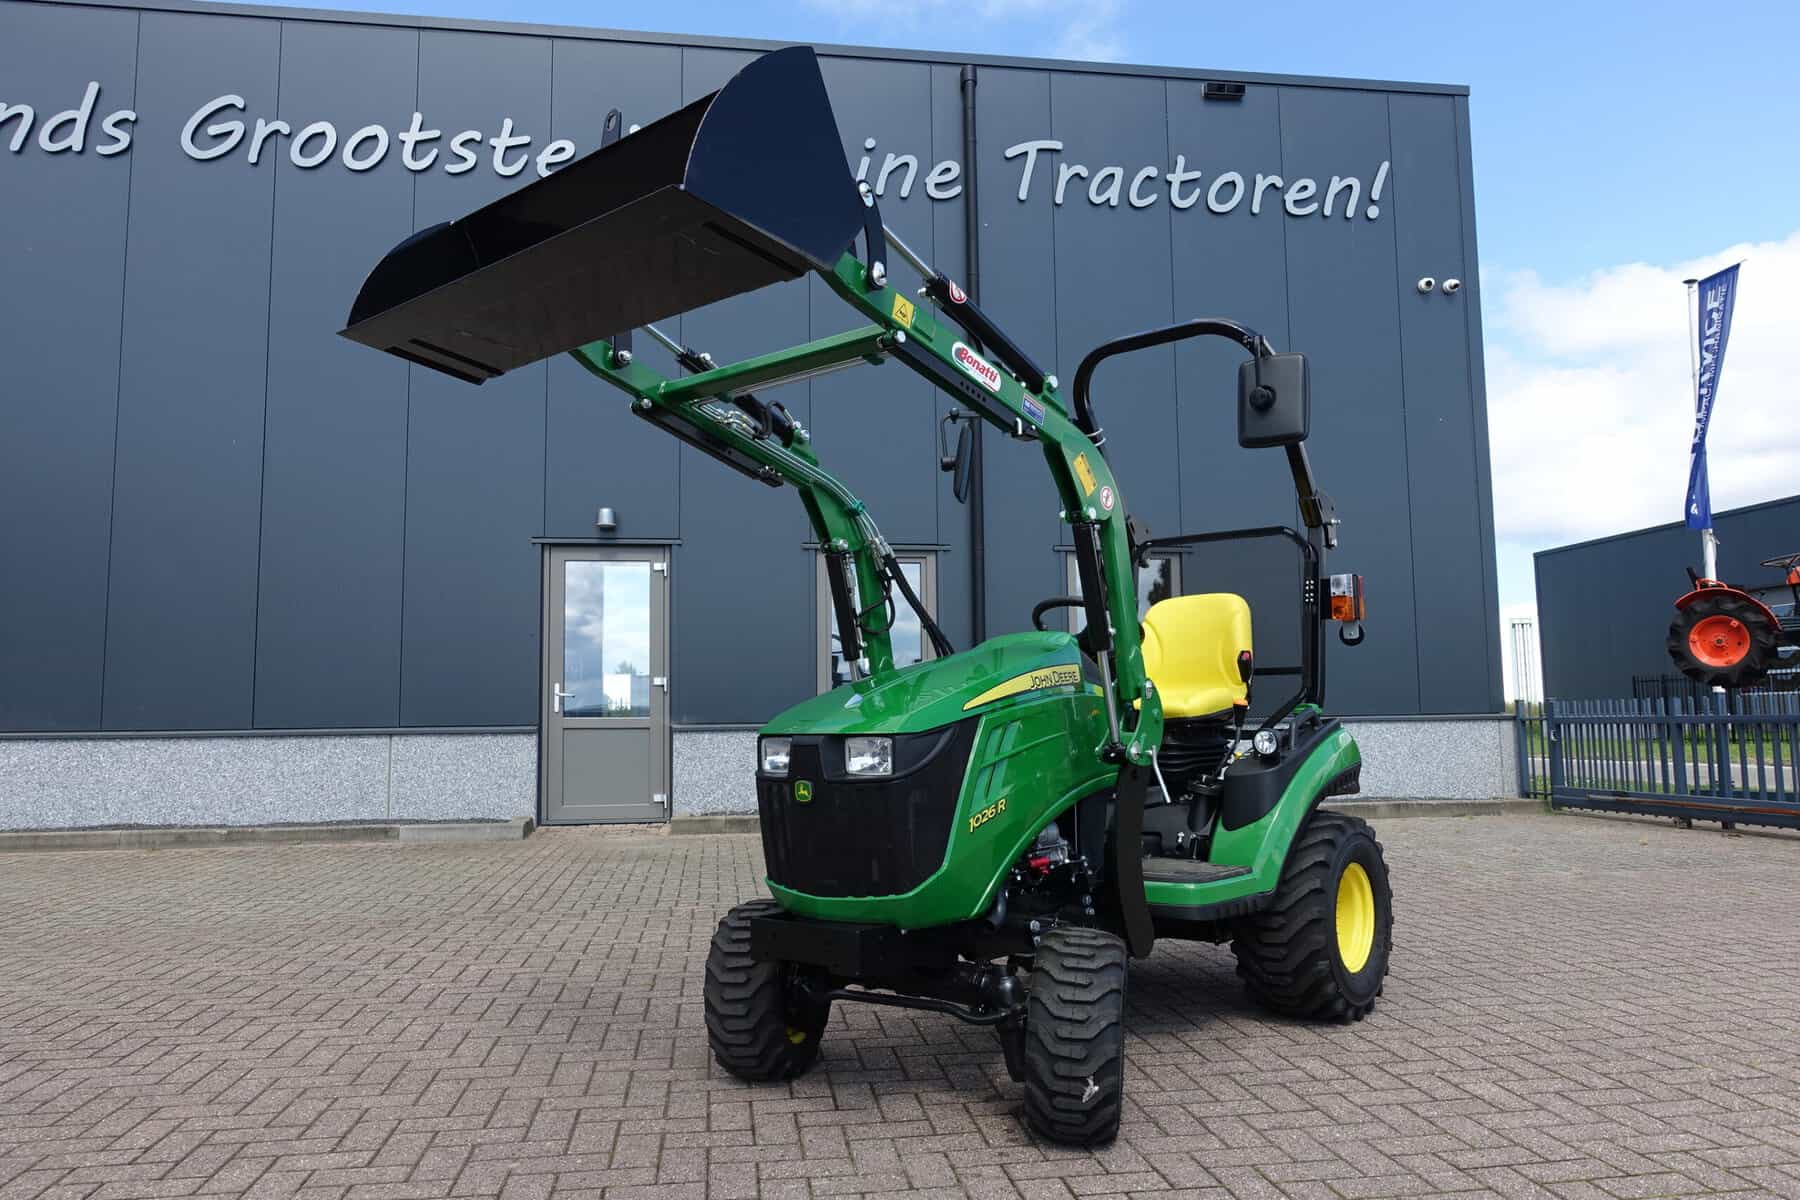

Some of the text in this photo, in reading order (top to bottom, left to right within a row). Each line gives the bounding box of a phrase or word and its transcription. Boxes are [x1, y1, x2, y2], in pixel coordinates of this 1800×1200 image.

[181, 94, 576, 178] Grootste
[1004, 139, 1389, 220] Tractoren!
[959, 347, 998, 383] Bonatti
[1030, 671, 1079, 689] JOHN DEERE
[969, 798, 1007, 832] 1026 R
